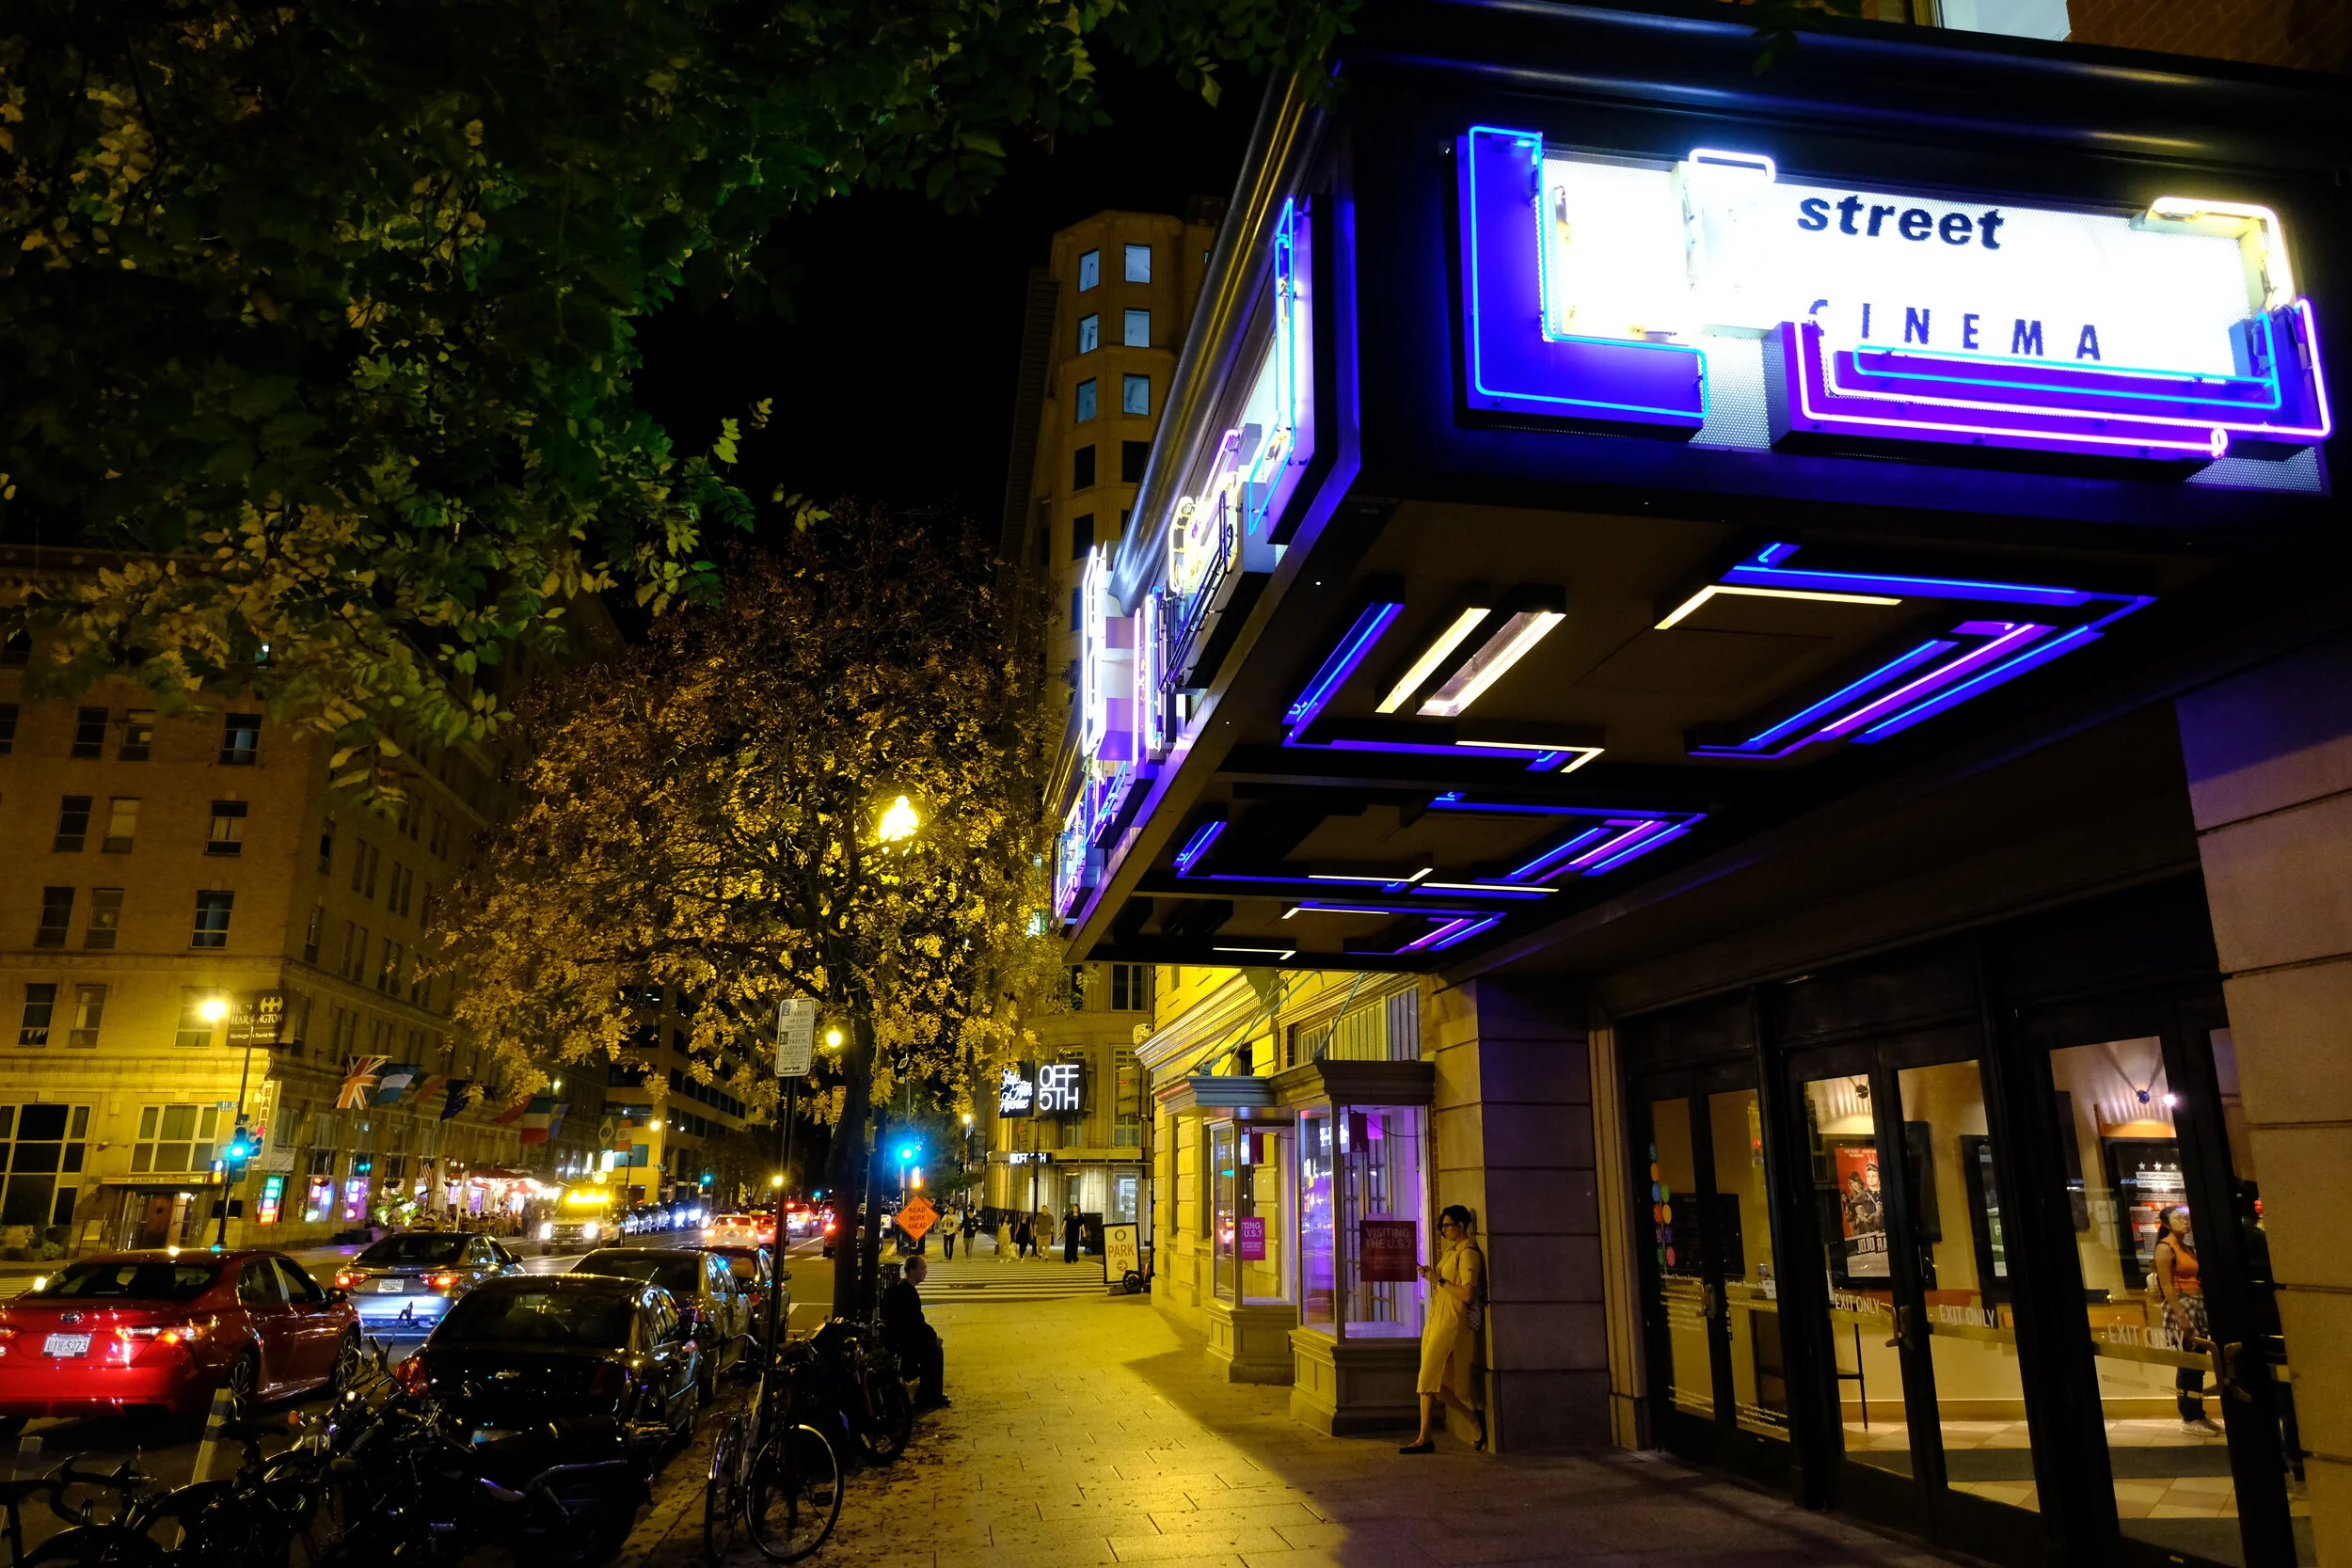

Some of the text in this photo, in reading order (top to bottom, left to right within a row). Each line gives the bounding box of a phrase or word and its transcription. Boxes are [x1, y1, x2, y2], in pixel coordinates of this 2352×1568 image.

[1798, 195, 2005, 250] street
[1809, 299, 2101, 361] CINEMA
[1039, 1064, 1080, 1088] OFF
[1039, 1086, 1079, 1111] 5TH
[1365, 1238, 1385, 1249] THE
[1366, 1227, 1410, 1239] VISITING
[1857, 1236, 1875, 1254] JOJO
[1108, 1243, 1135, 1258] PARK
[1835, 1293, 1880, 1316] EXIT ONLY
[1939, 1304, 1995, 1328] EXIT ONLY
[2108, 1323, 2185, 1352] EXIT ONLY
